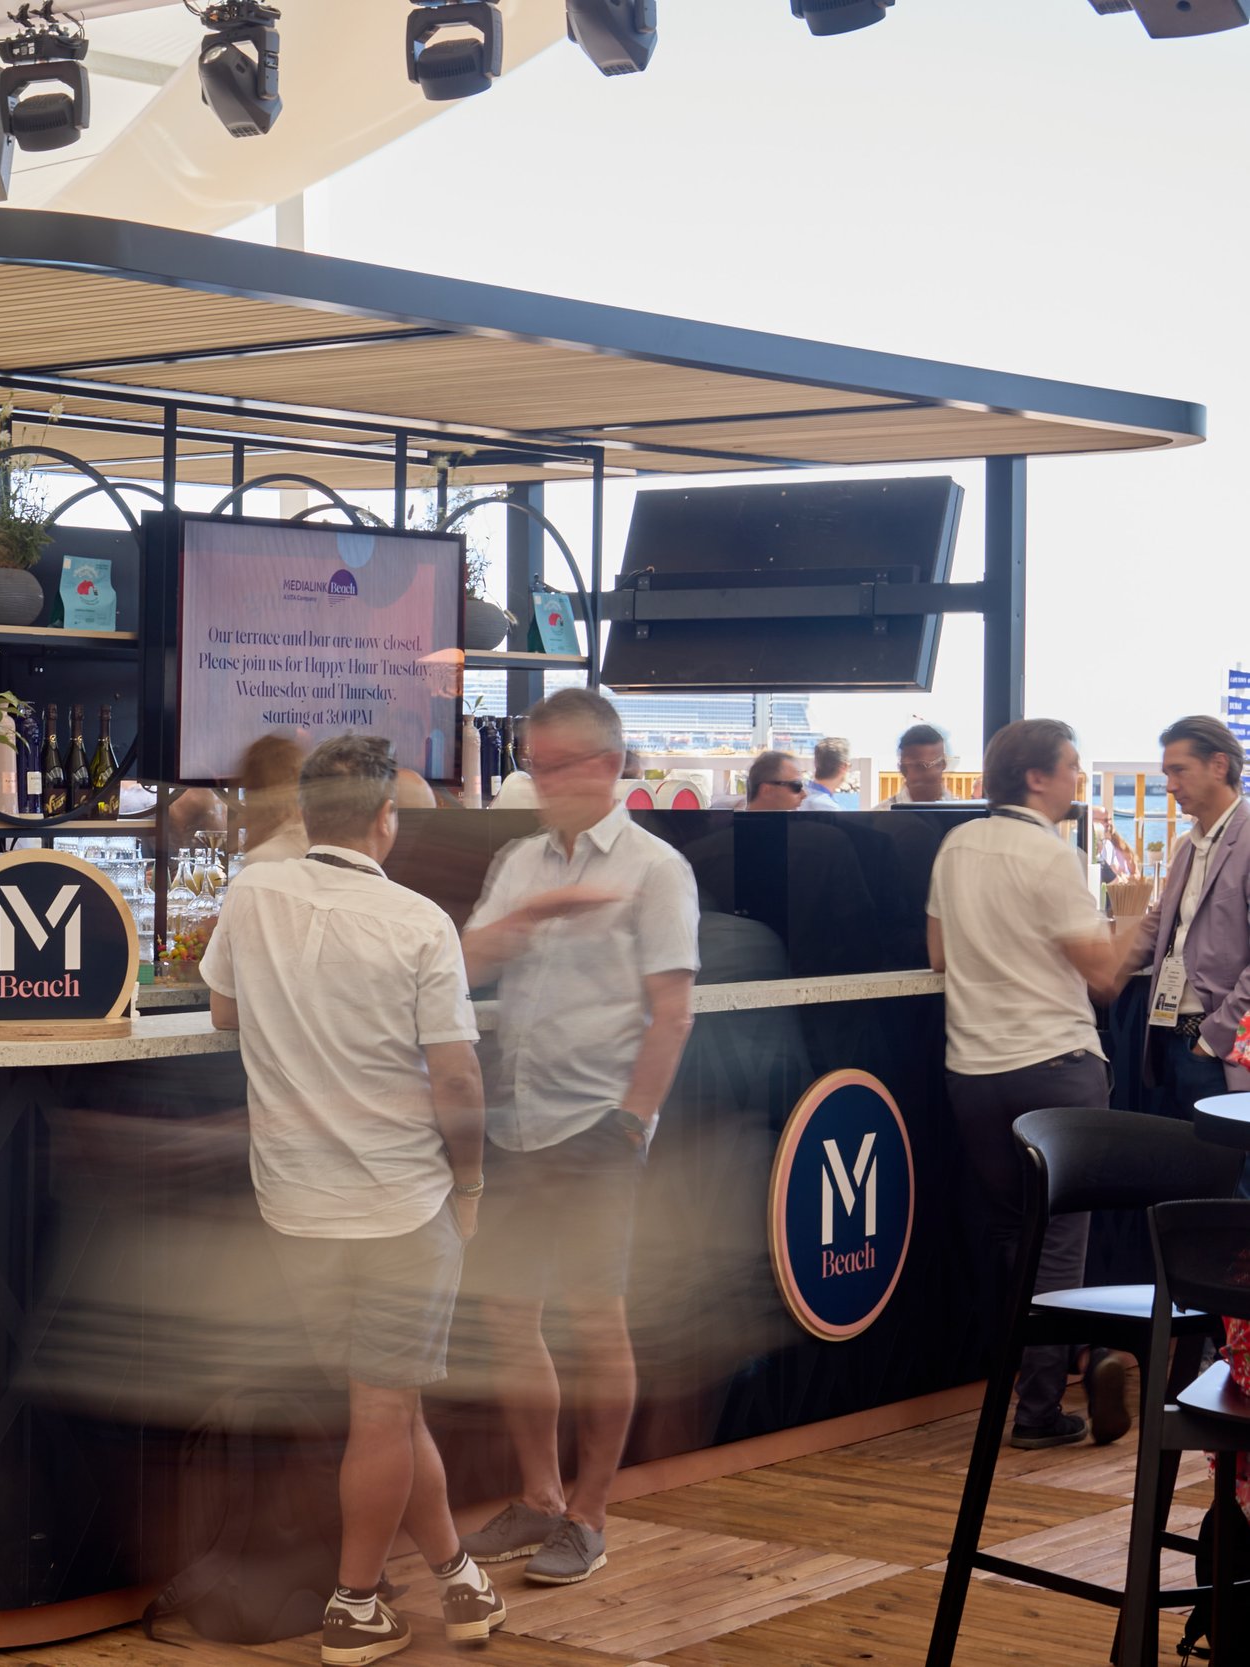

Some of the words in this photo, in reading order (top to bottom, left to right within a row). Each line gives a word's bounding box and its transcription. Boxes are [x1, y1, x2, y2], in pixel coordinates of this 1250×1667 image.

[283, 580, 328, 592] MEDIALINK
[330, 582, 356, 594] Beach
[208, 626, 233, 644] Our
[236, 630, 280, 645] terrace
[282, 630, 306, 646] and
[310, 630, 330, 647] bar
[332, 636, 352, 648] are
[354, 637, 380, 648] now
[384, 634, 422, 651] closed.
[199, 652, 240, 670] Please
[240, 654, 266, 675] join
[269, 659, 282, 672] us
[286, 656, 302, 672] for
[305, 656, 346, 678] Happy
[349, 658, 378, 674] Hour
[236, 680, 309, 702] Wednesday
[312, 683, 335, 699] and
[262, 708, 310, 728] starting
[312, 710, 324, 724] at
[326, 708, 372, 725] 3:00PM
[0, 973, 80, 998] Beach
[822, 1132, 877, 1246] M
[822, 1240, 876, 1279] Beach
